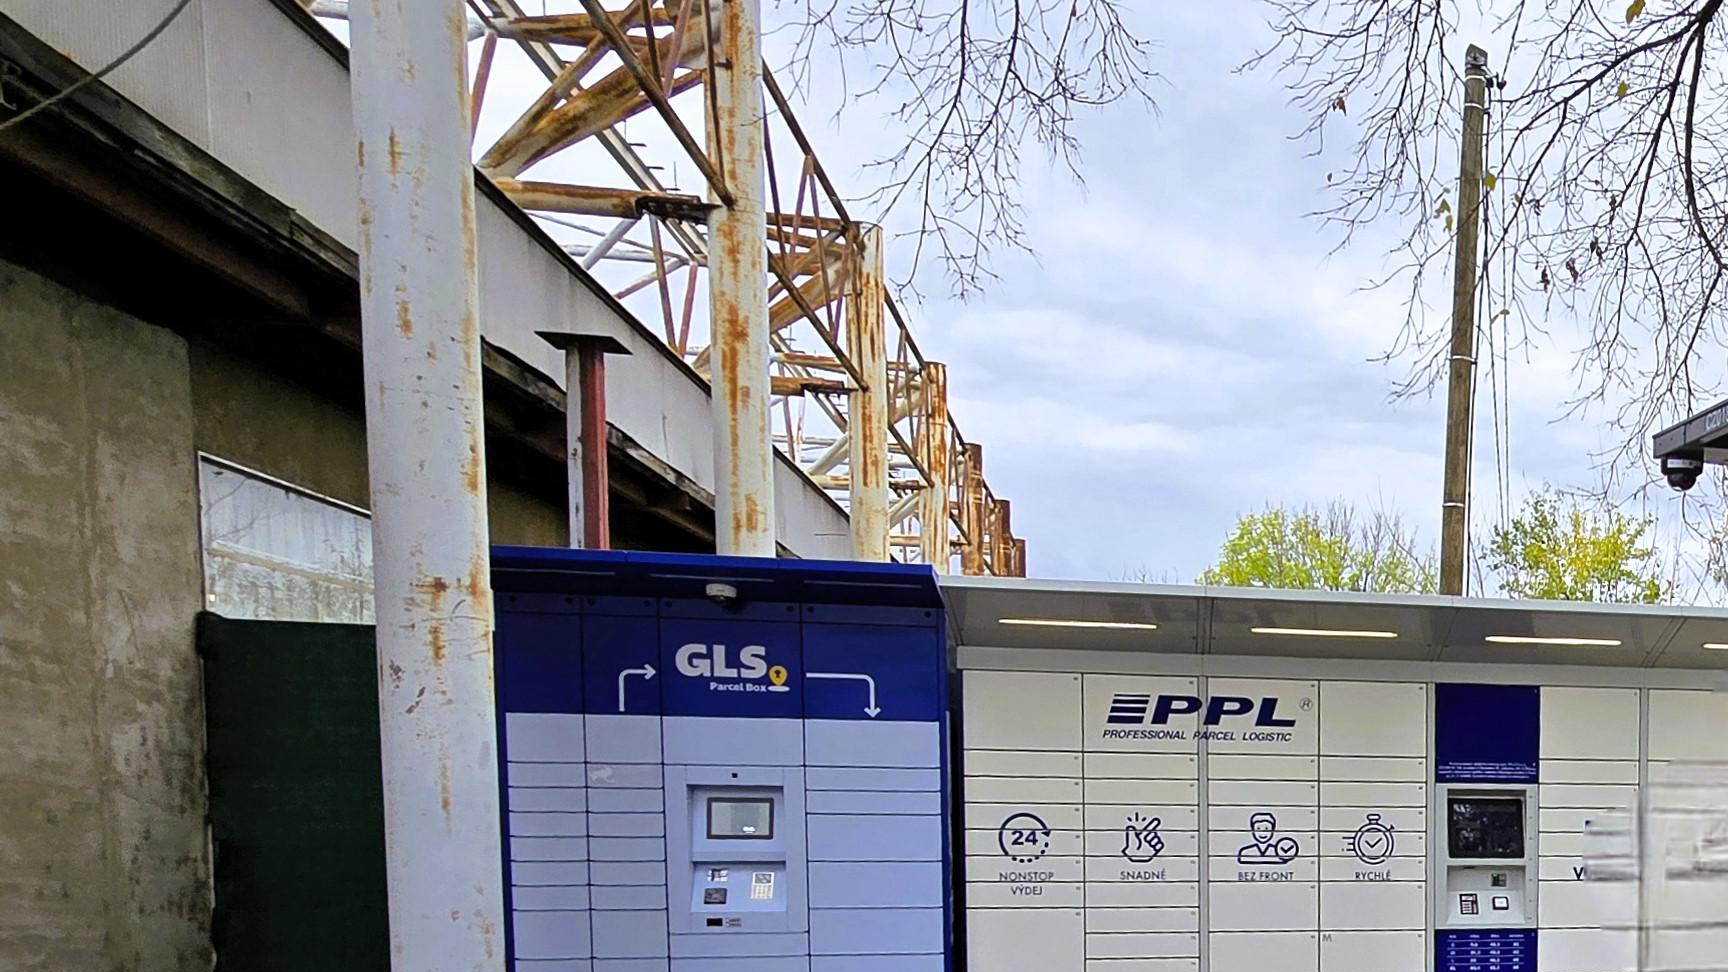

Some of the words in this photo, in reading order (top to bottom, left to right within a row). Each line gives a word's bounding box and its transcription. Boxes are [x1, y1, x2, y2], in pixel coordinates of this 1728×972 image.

[675, 643, 768, 678] GLS
[709, 682, 744, 691] Parcel
[745, 683, 767, 692] Box
[1150, 695, 1297, 728] PPL
[1102, 729, 1187, 740] PROFESSIONAL
[1192, 731, 1236, 741] PARCEL
[1242, 732, 1292, 742] LOGISTIC
[1011, 830, 1039, 846] 24
[999, 871, 1054, 881] NONSTOP
[1119, 868, 1167, 880] SNADNÉ
[1238, 871, 1256, 881] BEZ
[1259, 871, 1295, 881] FRONT
[1354, 869, 1392, 880] RYCHLÉ
[1010, 884, 1043, 896] VÝDEJ
[1322, 933, 1333, 942] M
